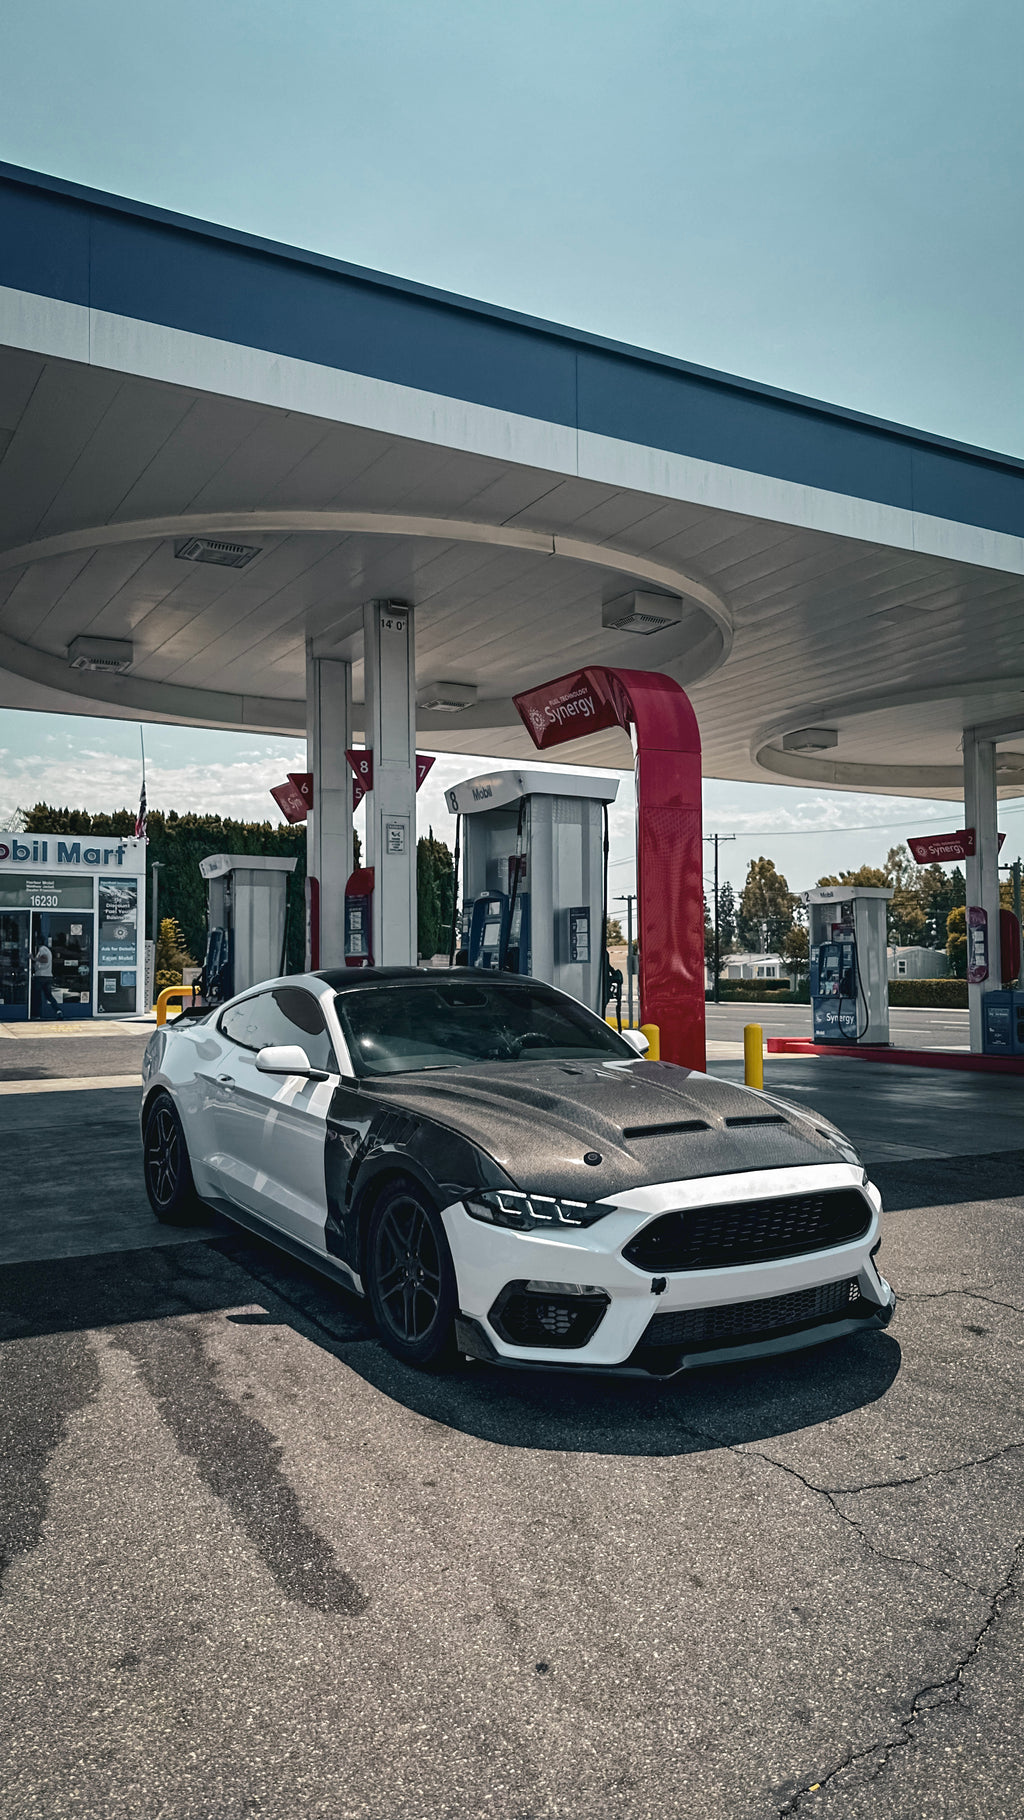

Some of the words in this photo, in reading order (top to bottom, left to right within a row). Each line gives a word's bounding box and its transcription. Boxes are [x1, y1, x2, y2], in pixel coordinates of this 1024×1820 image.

[560, 687, 588, 703] TECHNOLOGY
[544, 696, 595, 725] Synergy
[360, 760, 369, 773] 8
[418, 765, 426, 778] 7
[301, 782, 309, 794] 6
[355, 788, 362, 799] 5
[472, 785, 493, 801] Mobil
[450, 791, 459, 811] 8
[968, 836, 973, 845] 2
[57, 841, 125, 865] Mart
[30, 895, 58, 907] 16230
[804, 892, 810, 902] 2
[826, 1012, 855, 1025] Synergy
